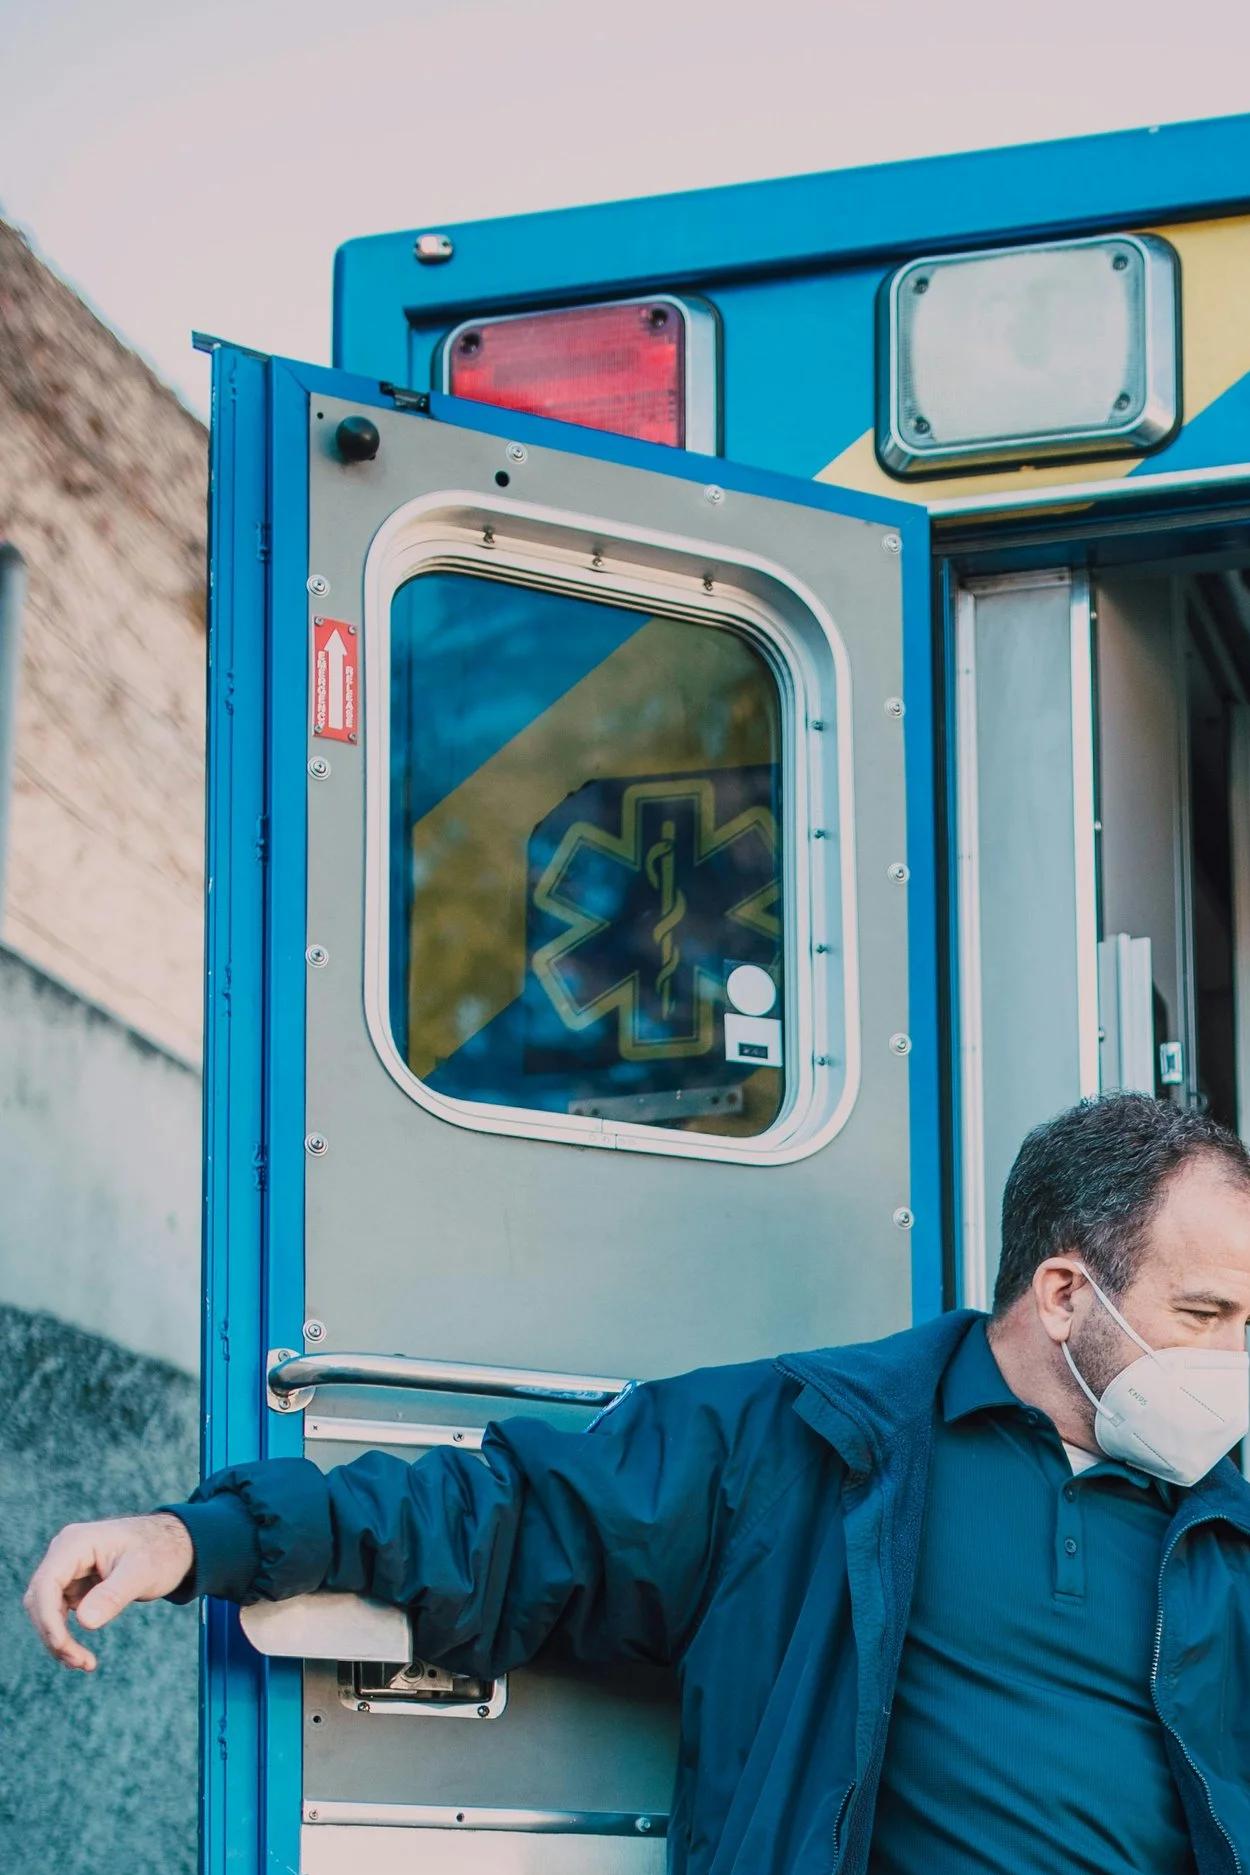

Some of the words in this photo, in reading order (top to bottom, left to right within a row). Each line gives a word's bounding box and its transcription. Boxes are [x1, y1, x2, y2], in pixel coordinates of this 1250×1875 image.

[317, 651, 327, 728] EMERGENCY
[345, 665, 354, 728] RELEASE
[1128, 1388, 1147, 1406] KN95
